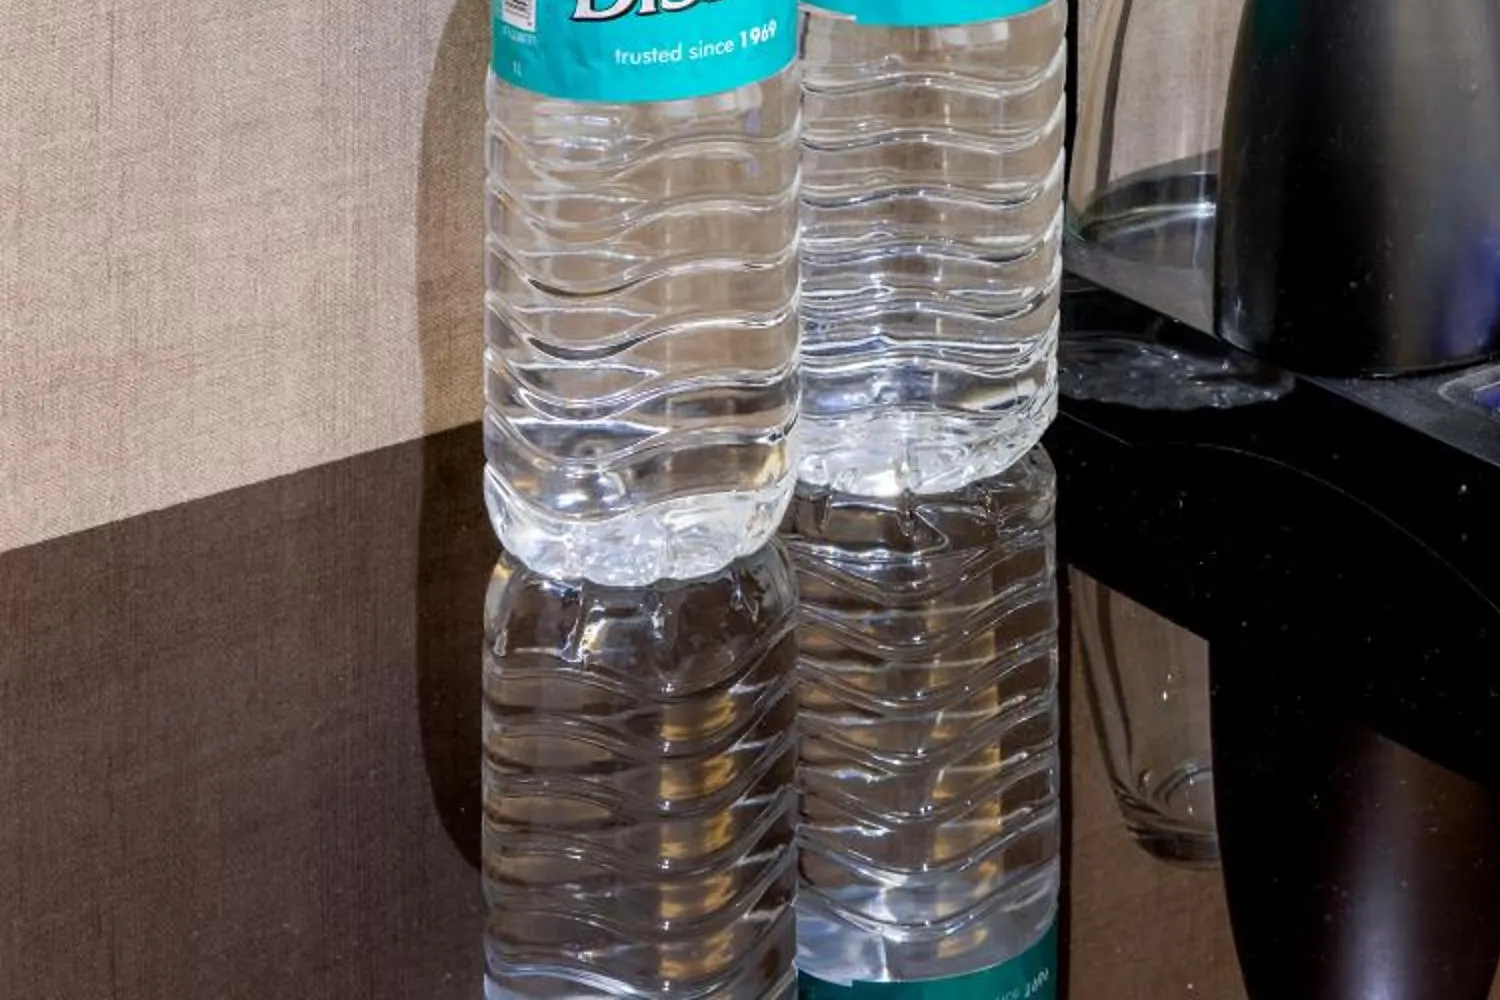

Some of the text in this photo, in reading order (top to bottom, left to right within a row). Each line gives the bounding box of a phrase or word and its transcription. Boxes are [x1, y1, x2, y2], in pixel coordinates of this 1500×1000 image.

[614, 19, 778, 66] trusted since 1969
